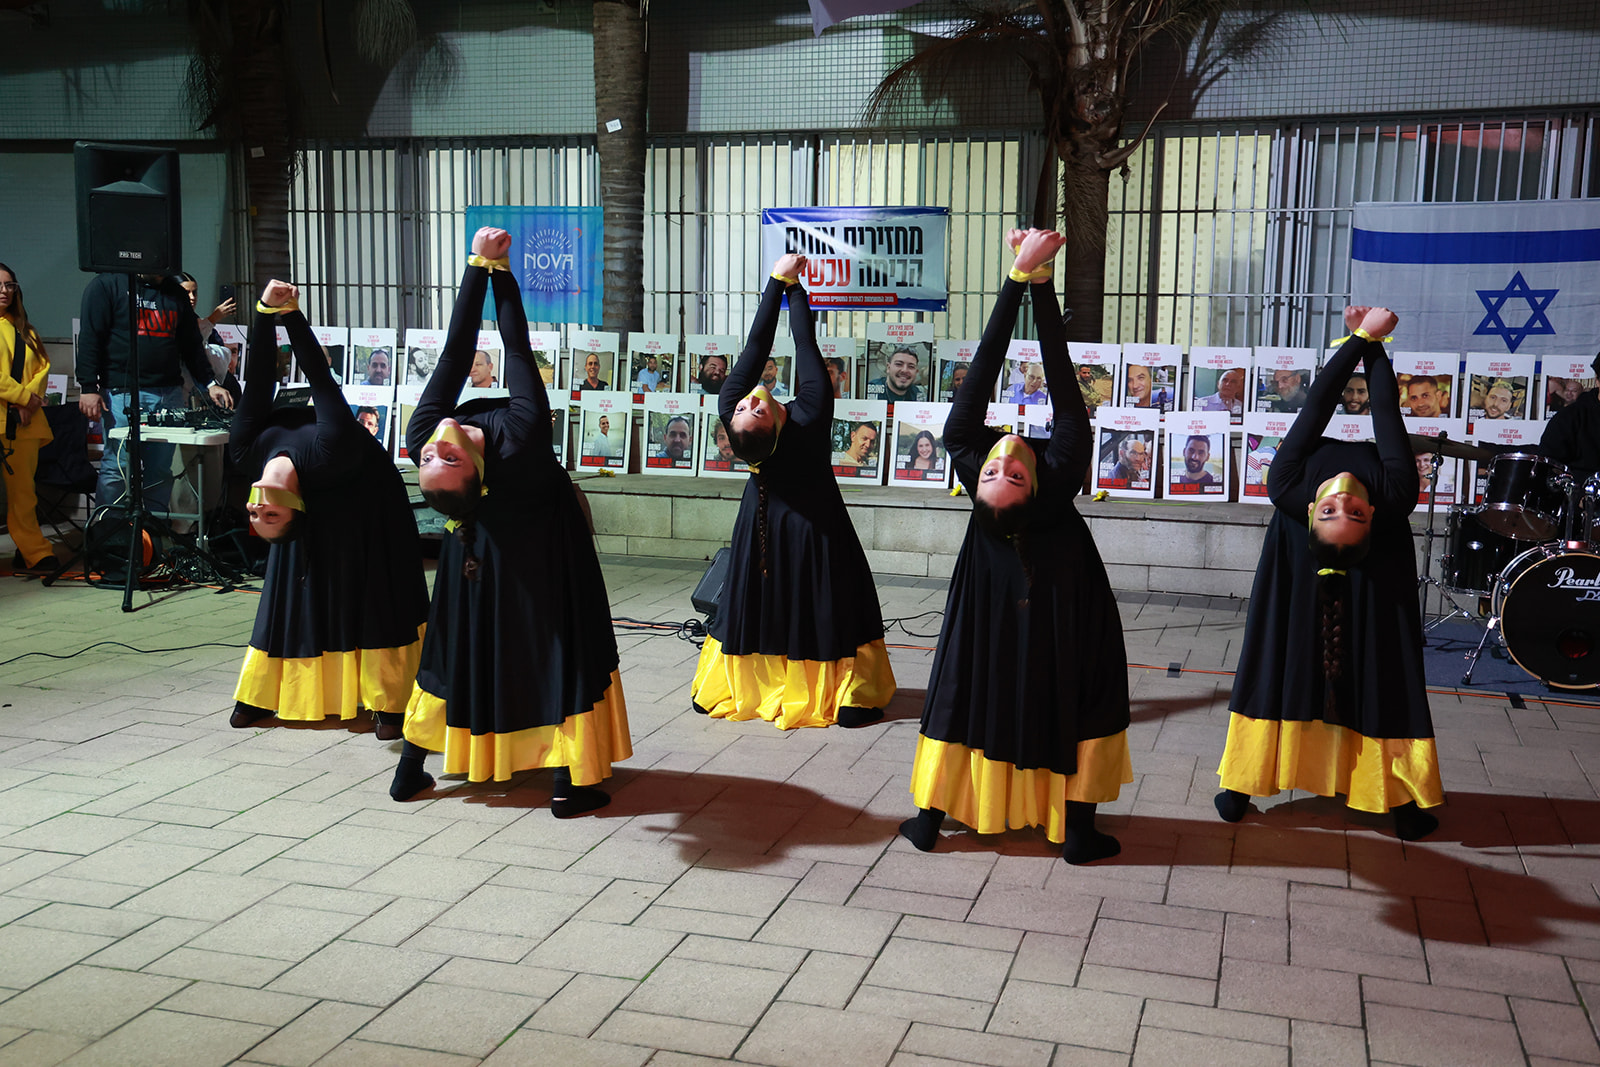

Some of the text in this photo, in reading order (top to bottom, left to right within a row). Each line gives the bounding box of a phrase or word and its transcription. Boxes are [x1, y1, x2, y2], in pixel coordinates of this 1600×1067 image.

[785, 226, 923, 255] מחזירים אותם
[524, 253, 574, 270] NOVA
[800, 258, 923, 288] הביתה עכשי
[867, 384, 885, 394] BRING
[1547, 566, 1600, 588] Pearl
